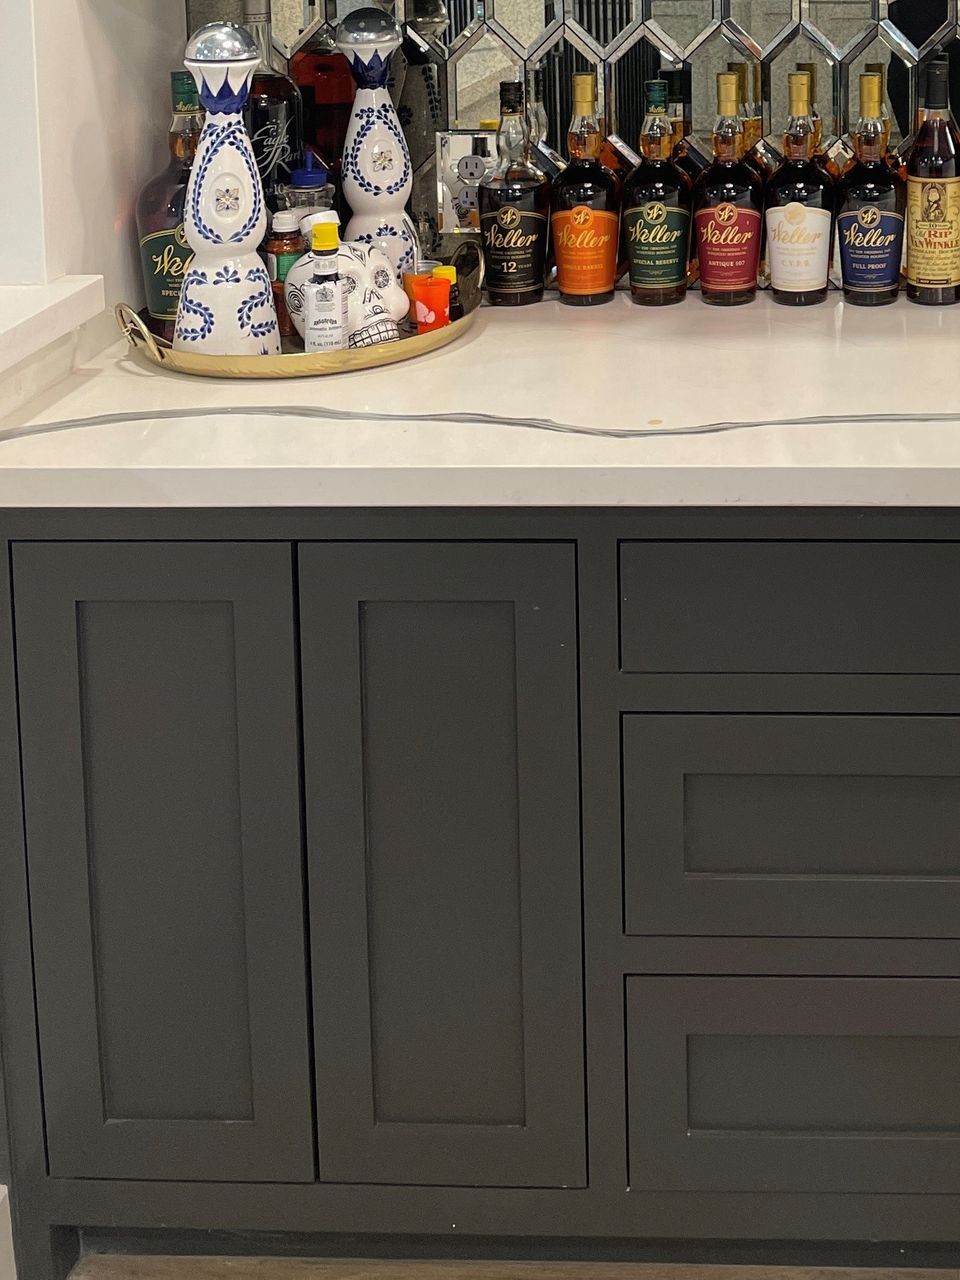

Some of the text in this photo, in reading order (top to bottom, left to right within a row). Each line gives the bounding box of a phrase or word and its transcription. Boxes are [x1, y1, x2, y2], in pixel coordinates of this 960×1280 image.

[484, 223, 539, 249] Weller
[558, 223, 611, 249] Weller
[629, 218, 682, 244] Weller
[700, 220, 754, 245] Weller
[770, 221, 822, 245] Weller
[843, 222, 897, 248] Weller
[928, 230, 952, 238] RIP
[924, 237, 960, 250] WINKLE
[501, 261, 517, 273] 12
[633, 257, 680, 266] SPECIAL RESERVE
